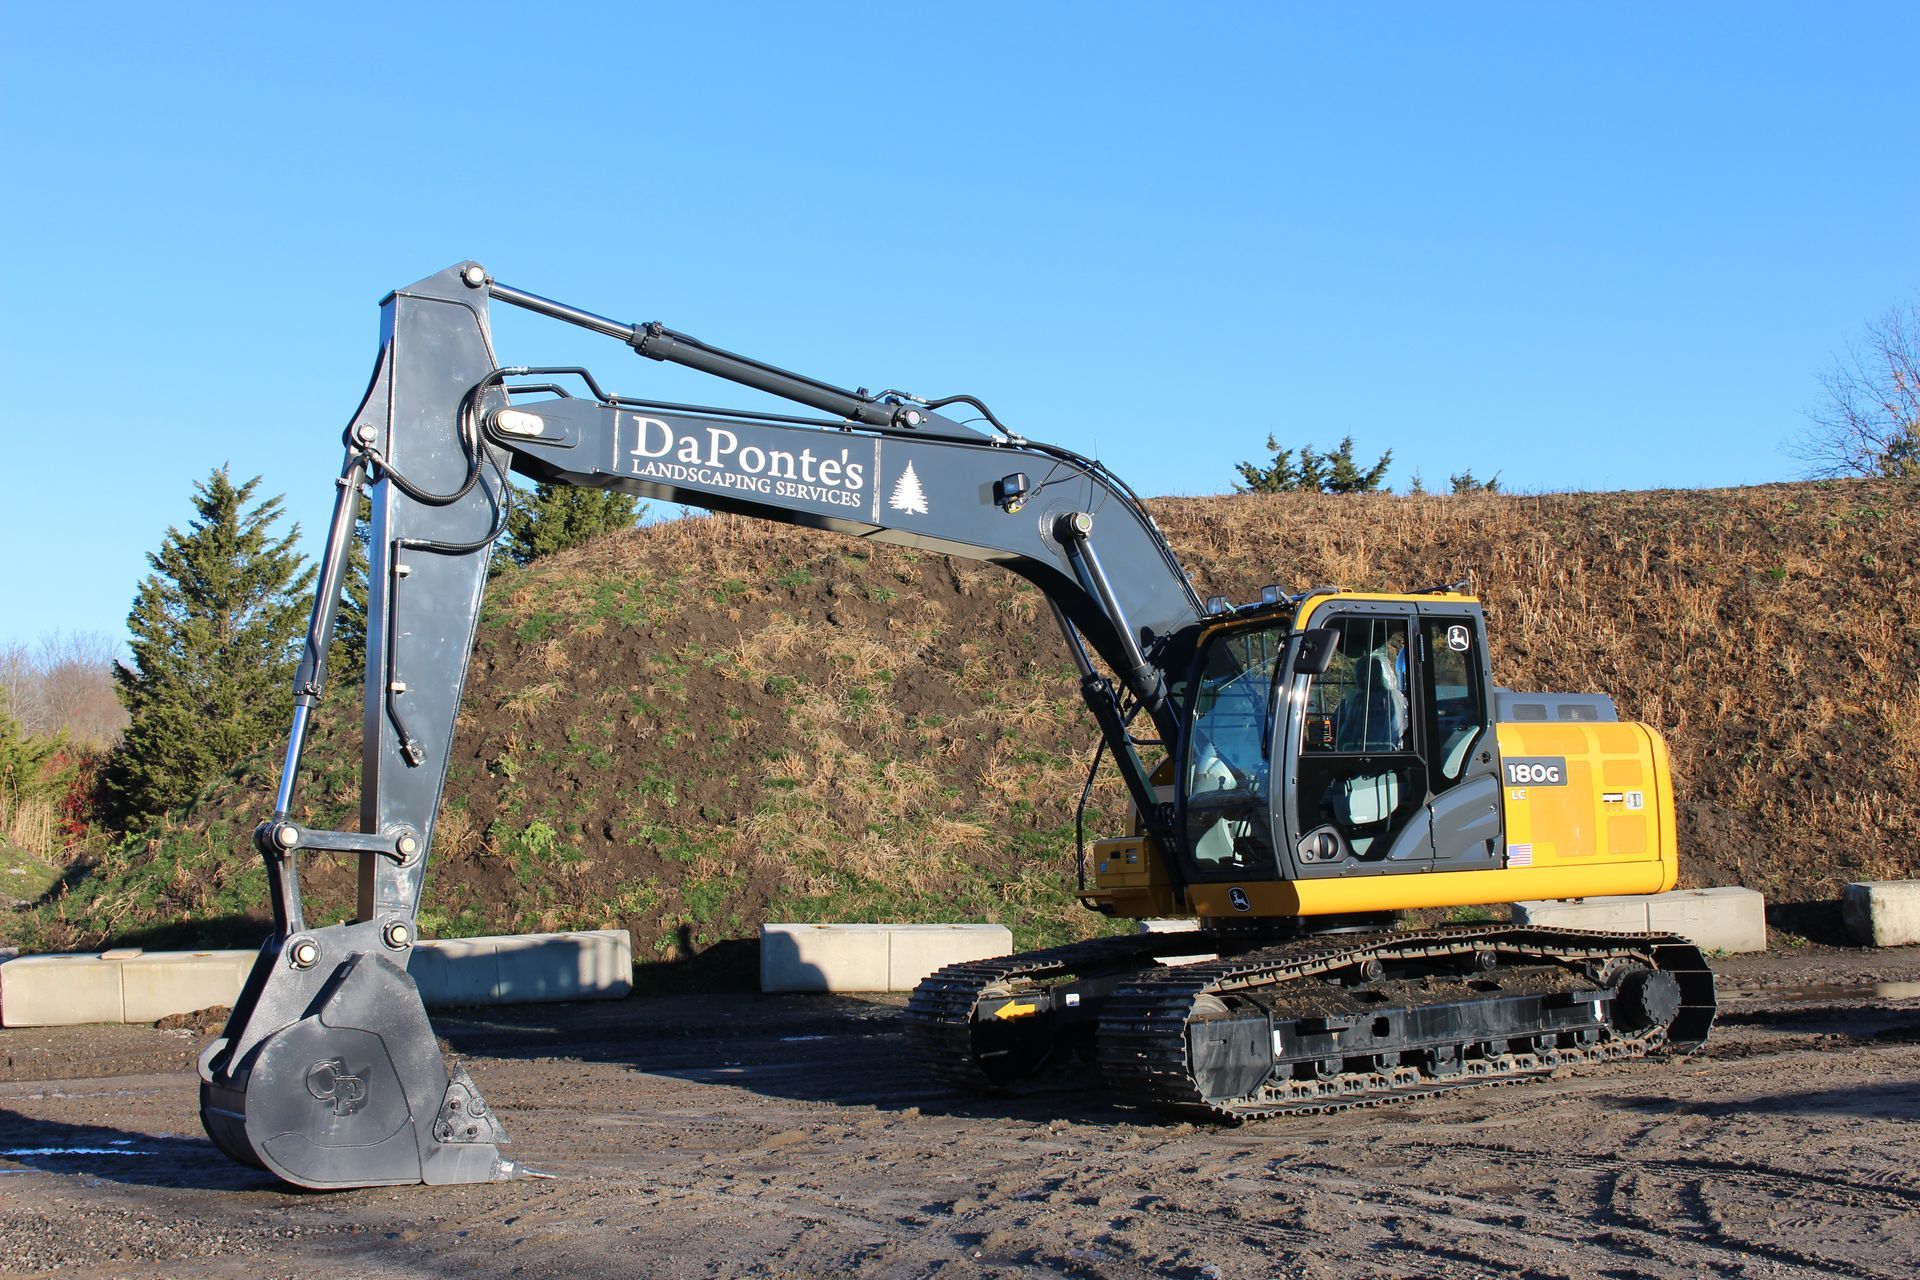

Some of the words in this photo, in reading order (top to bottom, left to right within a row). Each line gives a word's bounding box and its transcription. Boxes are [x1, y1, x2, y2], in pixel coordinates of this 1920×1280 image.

[630, 415, 864, 490] DaPonte's
[631, 458, 772, 495] LANDSCAPING
[775, 480, 861, 508] SERVICES
[1508, 763, 1560, 784] 180G
[1511, 788, 1527, 801] LC
